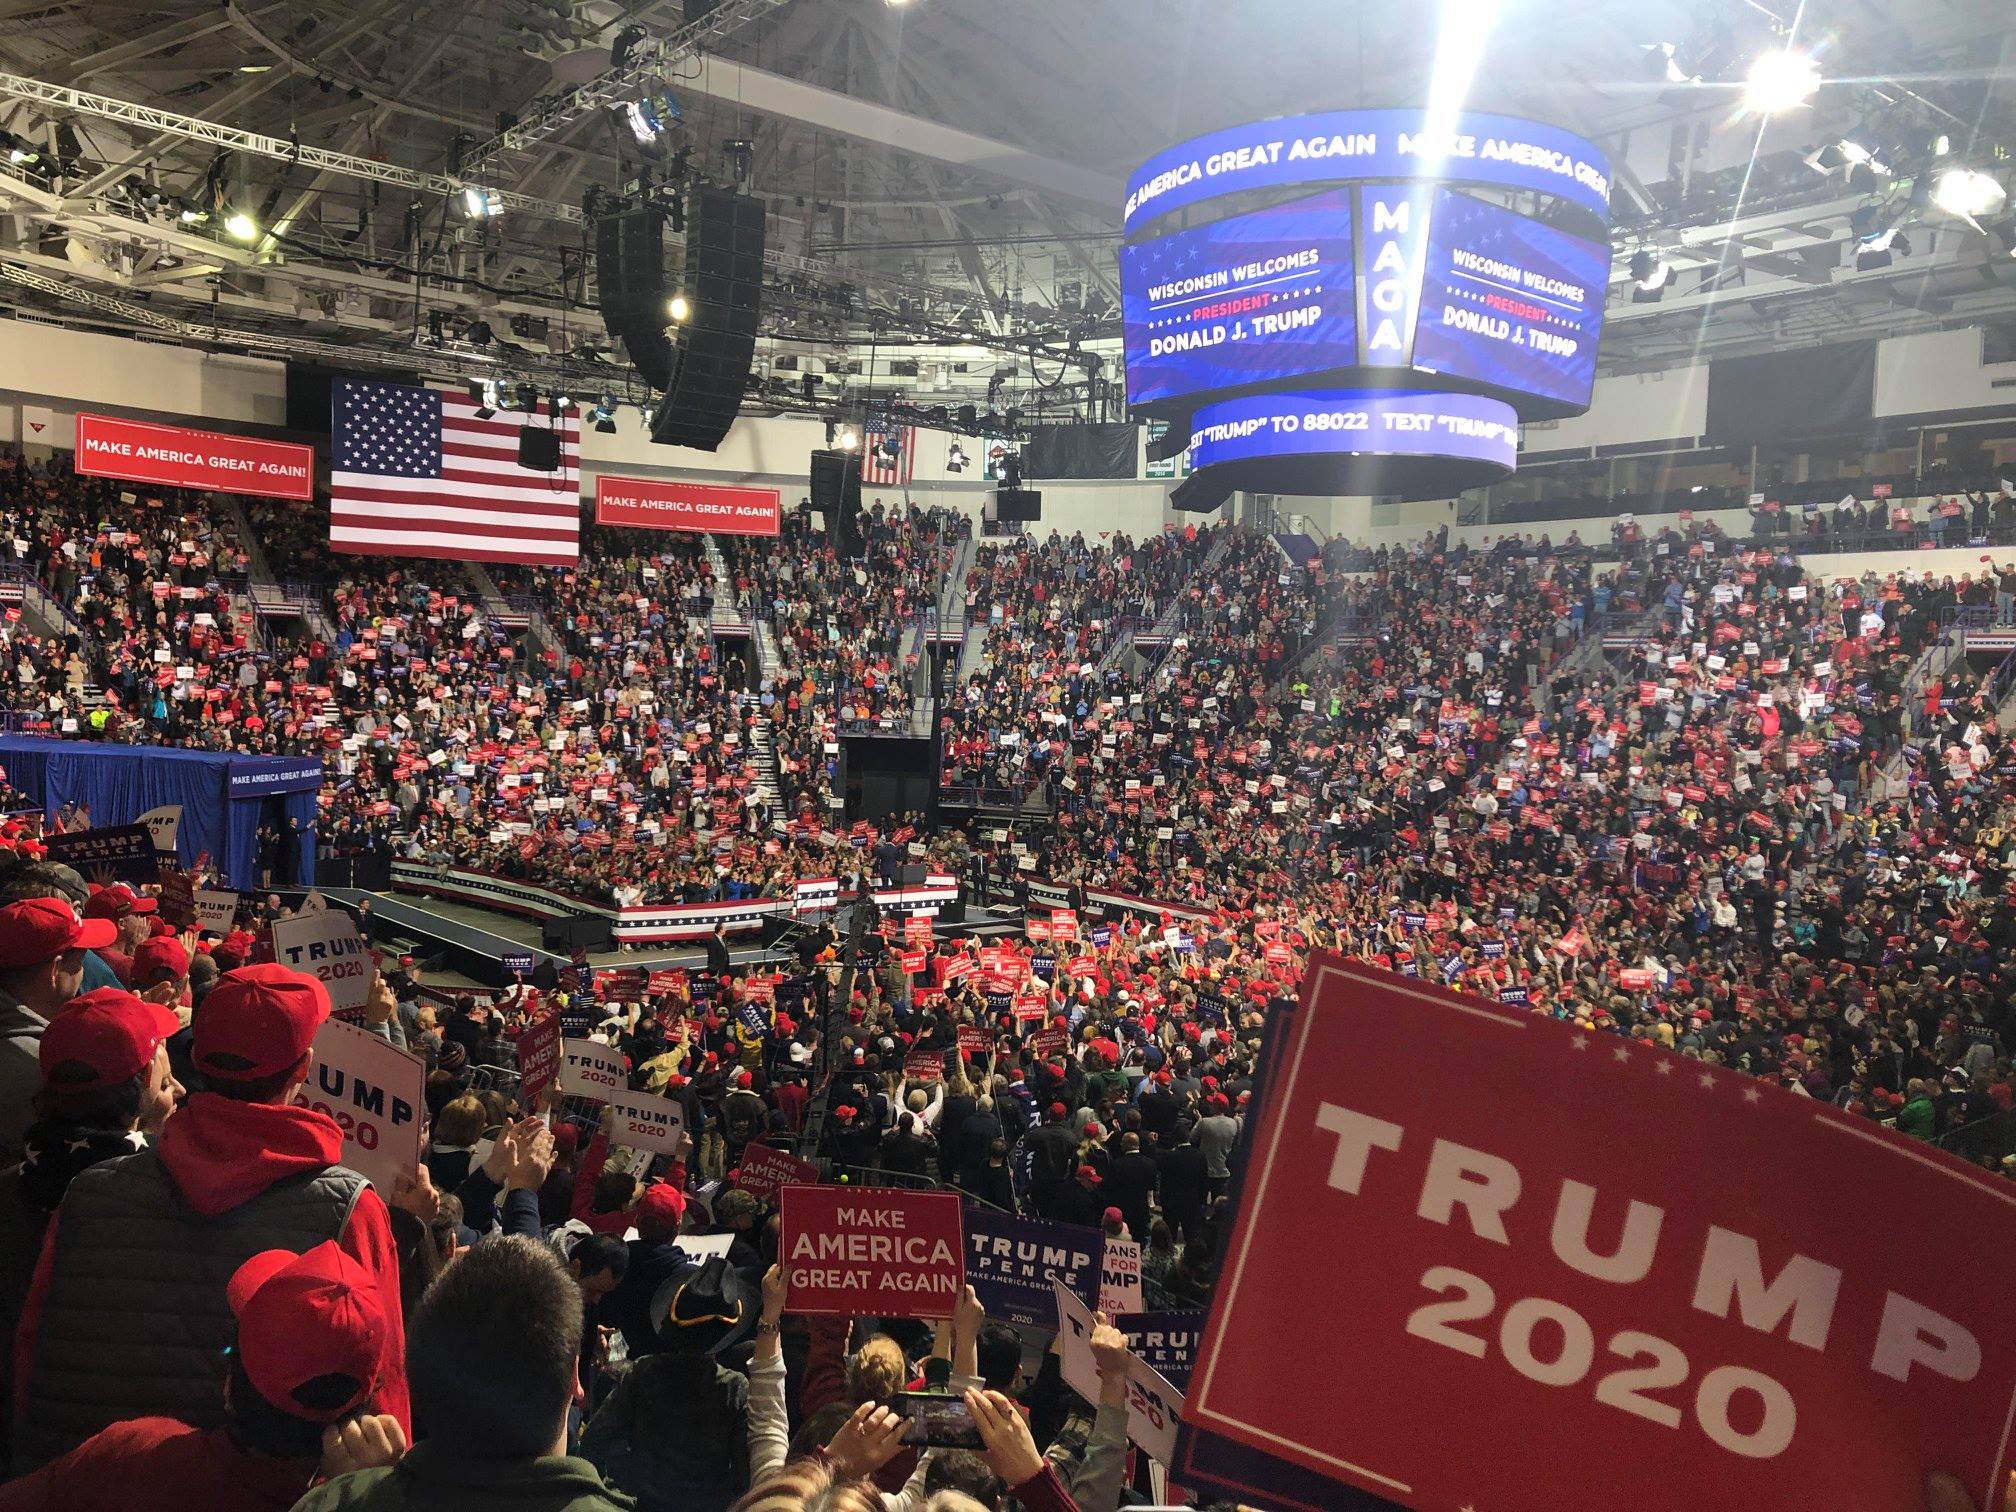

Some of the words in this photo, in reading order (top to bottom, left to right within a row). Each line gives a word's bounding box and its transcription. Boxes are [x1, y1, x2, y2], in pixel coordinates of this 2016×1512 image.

[1137, 161, 1202, 206] AMERICA
[1205, 142, 1283, 175] GREAT
[1288, 134, 1376, 161] AGAIN
[1480, 138, 1573, 177] AMERICA
[1148, 270, 1228, 302] WISCONSIN
[1232, 249, 1319, 282] WELCOMES
[1369, 200, 1410, 350] MAGA
[1453, 248, 1521, 283] WISCONSIN
[1524, 271, 1584, 303] WELCOMES
[1193, 293, 1270, 321] PRESIDENT
[1486, 294, 1548, 321] PRESIDENT
[1150, 325, 1226, 357] DONALD
[1231, 322, 1247, 341] J.
[1252, 305, 1322, 336] TRUMP
[1443, 305, 1510, 340] DONALD
[1512, 326, 1525, 344] J.
[1529, 328, 1577, 357] TRUMP
[1271, 414, 1299, 433] TO
[1303, 412, 1369, 431] 88022
[1382, 412, 1434, 432] TEXT
[86, 438, 131, 456] MAKE
[135, 446, 204, 466] AMERICA
[208, 456, 255, 472] GREAT
[258, 462, 306, 478] AGAIN!
[603, 496, 637, 508] MAKE
[640, 499, 693, 513] AMERICA
[696, 504, 733, 515] GREAT
[736, 507, 774, 517] AGAIN!
[232, 776, 250, 785] MAKE
[251, 773, 280, 783] AMERICA
[280, 771, 300, 780] GREAT
[58, 834, 143, 852] TRUMP
[286, 937, 366, 965] TRUMP
[316, 961, 364, 982] 2020
[568, 1055, 625, 1077] TRUMP
[581, 1070, 616, 1086] 2020
[310, 1063, 413, 1126] UMP
[615, 1105, 679, 1126] TRUMP
[629, 1122, 666, 1137] 2020
[767, 1156, 797, 1174] MAKE
[740, 1177, 775, 1189] GREAT
[836, 1207, 906, 1229] MAKE
[791, 1232, 956, 1266] AMERICA
[971, 1233, 1091, 1270] TRUMP
[1315, 1101, 1982, 1382] TRUMP
[979, 1256, 1077, 1286] PENCE
[1110, 1258, 1138, 1272] FOR
[791, 1269, 872, 1290] GREAT
[879, 1271, 957, 1294] AGAIN
[967, 1270, 989, 1280] MAKE
[991, 1274, 1027, 1287] AMERICA
[1011, 1313, 1033, 1324] 2020
[1127, 1331, 1199, 1348] TRU
[1406, 1266, 1797, 1459] 2020
